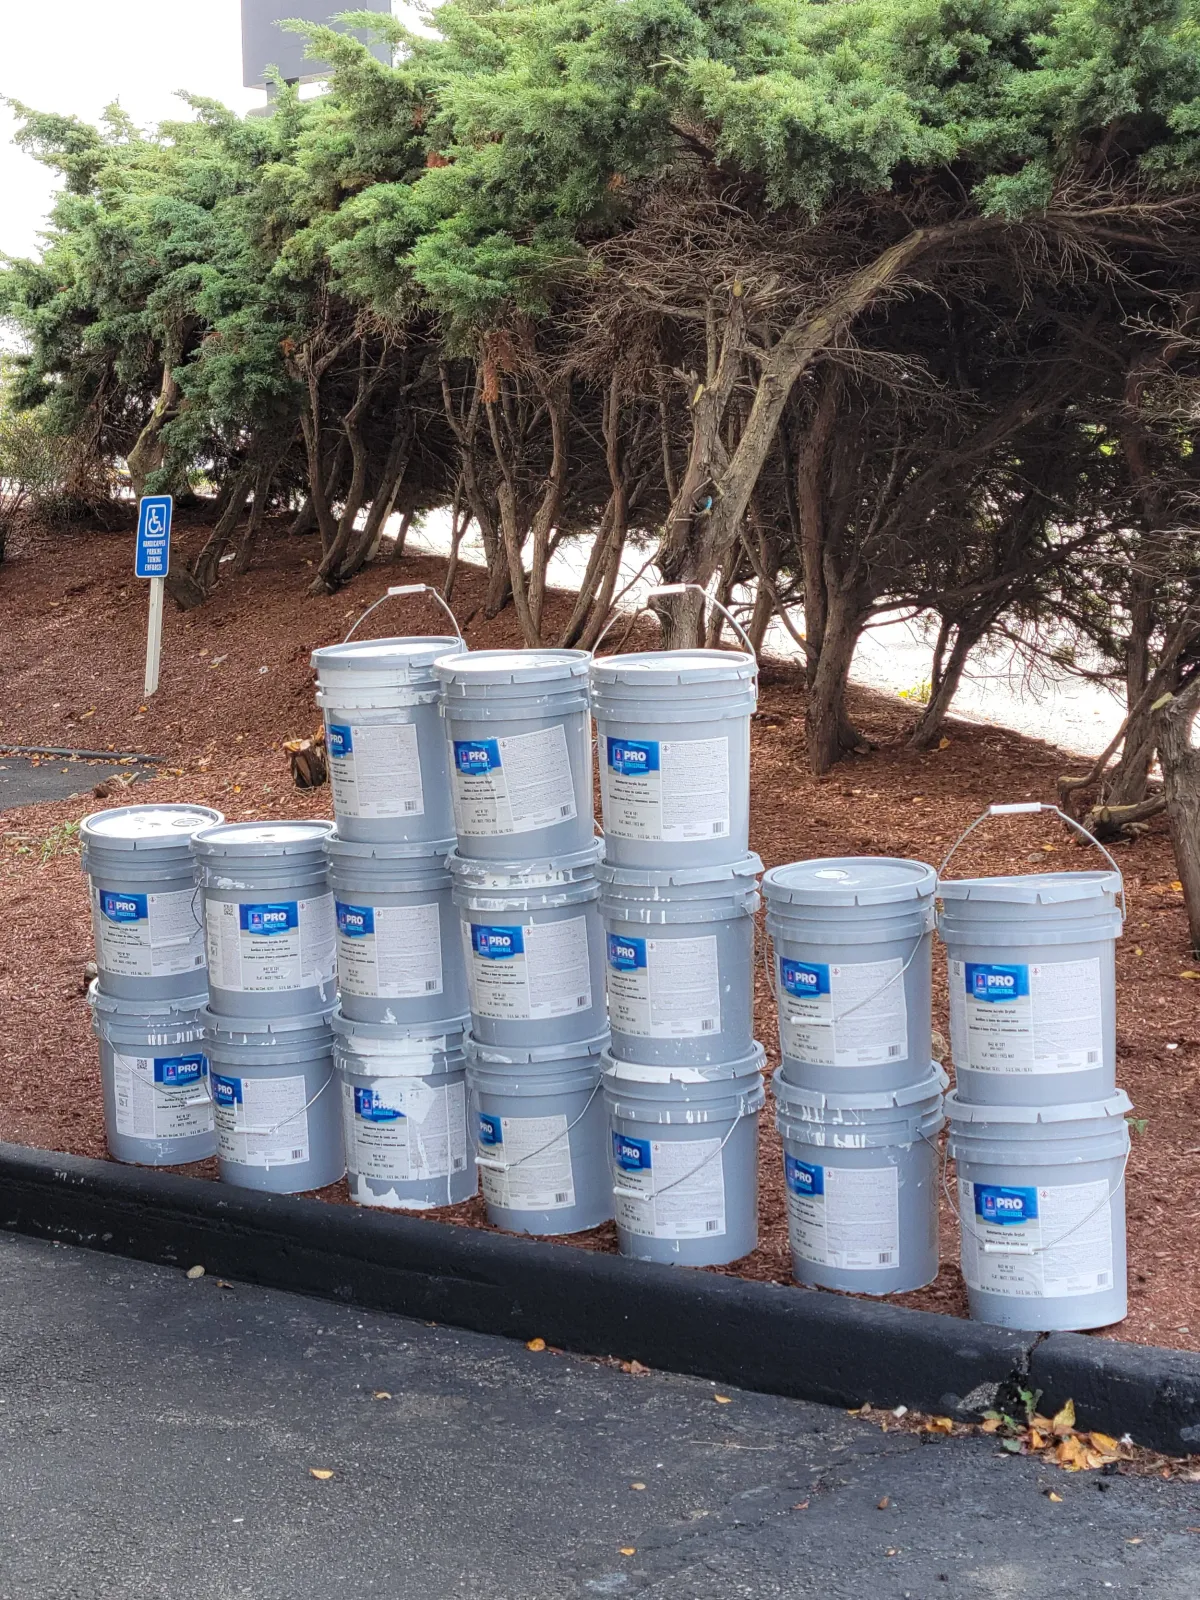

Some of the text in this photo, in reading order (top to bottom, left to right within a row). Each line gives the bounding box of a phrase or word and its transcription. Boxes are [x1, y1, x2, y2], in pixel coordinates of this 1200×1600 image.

[330, 734, 343, 744] PRO
[624, 751, 647, 761] PRO
[115, 902, 136, 911] PRO
[263, 912, 287, 922] PRO
[346, 914, 364, 925] PRO
[489, 936, 511, 946] PRO
[617, 946, 635, 958] PRO
[795, 972, 817, 984] PRO
[987, 975, 1015, 987] PRO
[178, 1063, 198, 1074] PRO
[217, 1084, 233, 1095] PRO
[480, 1121, 493, 1133] PRO
[622, 1145, 640, 1158] PRO
[794, 1170, 812, 1183] PRO
[996, 1197, 1023, 1209] PRO
